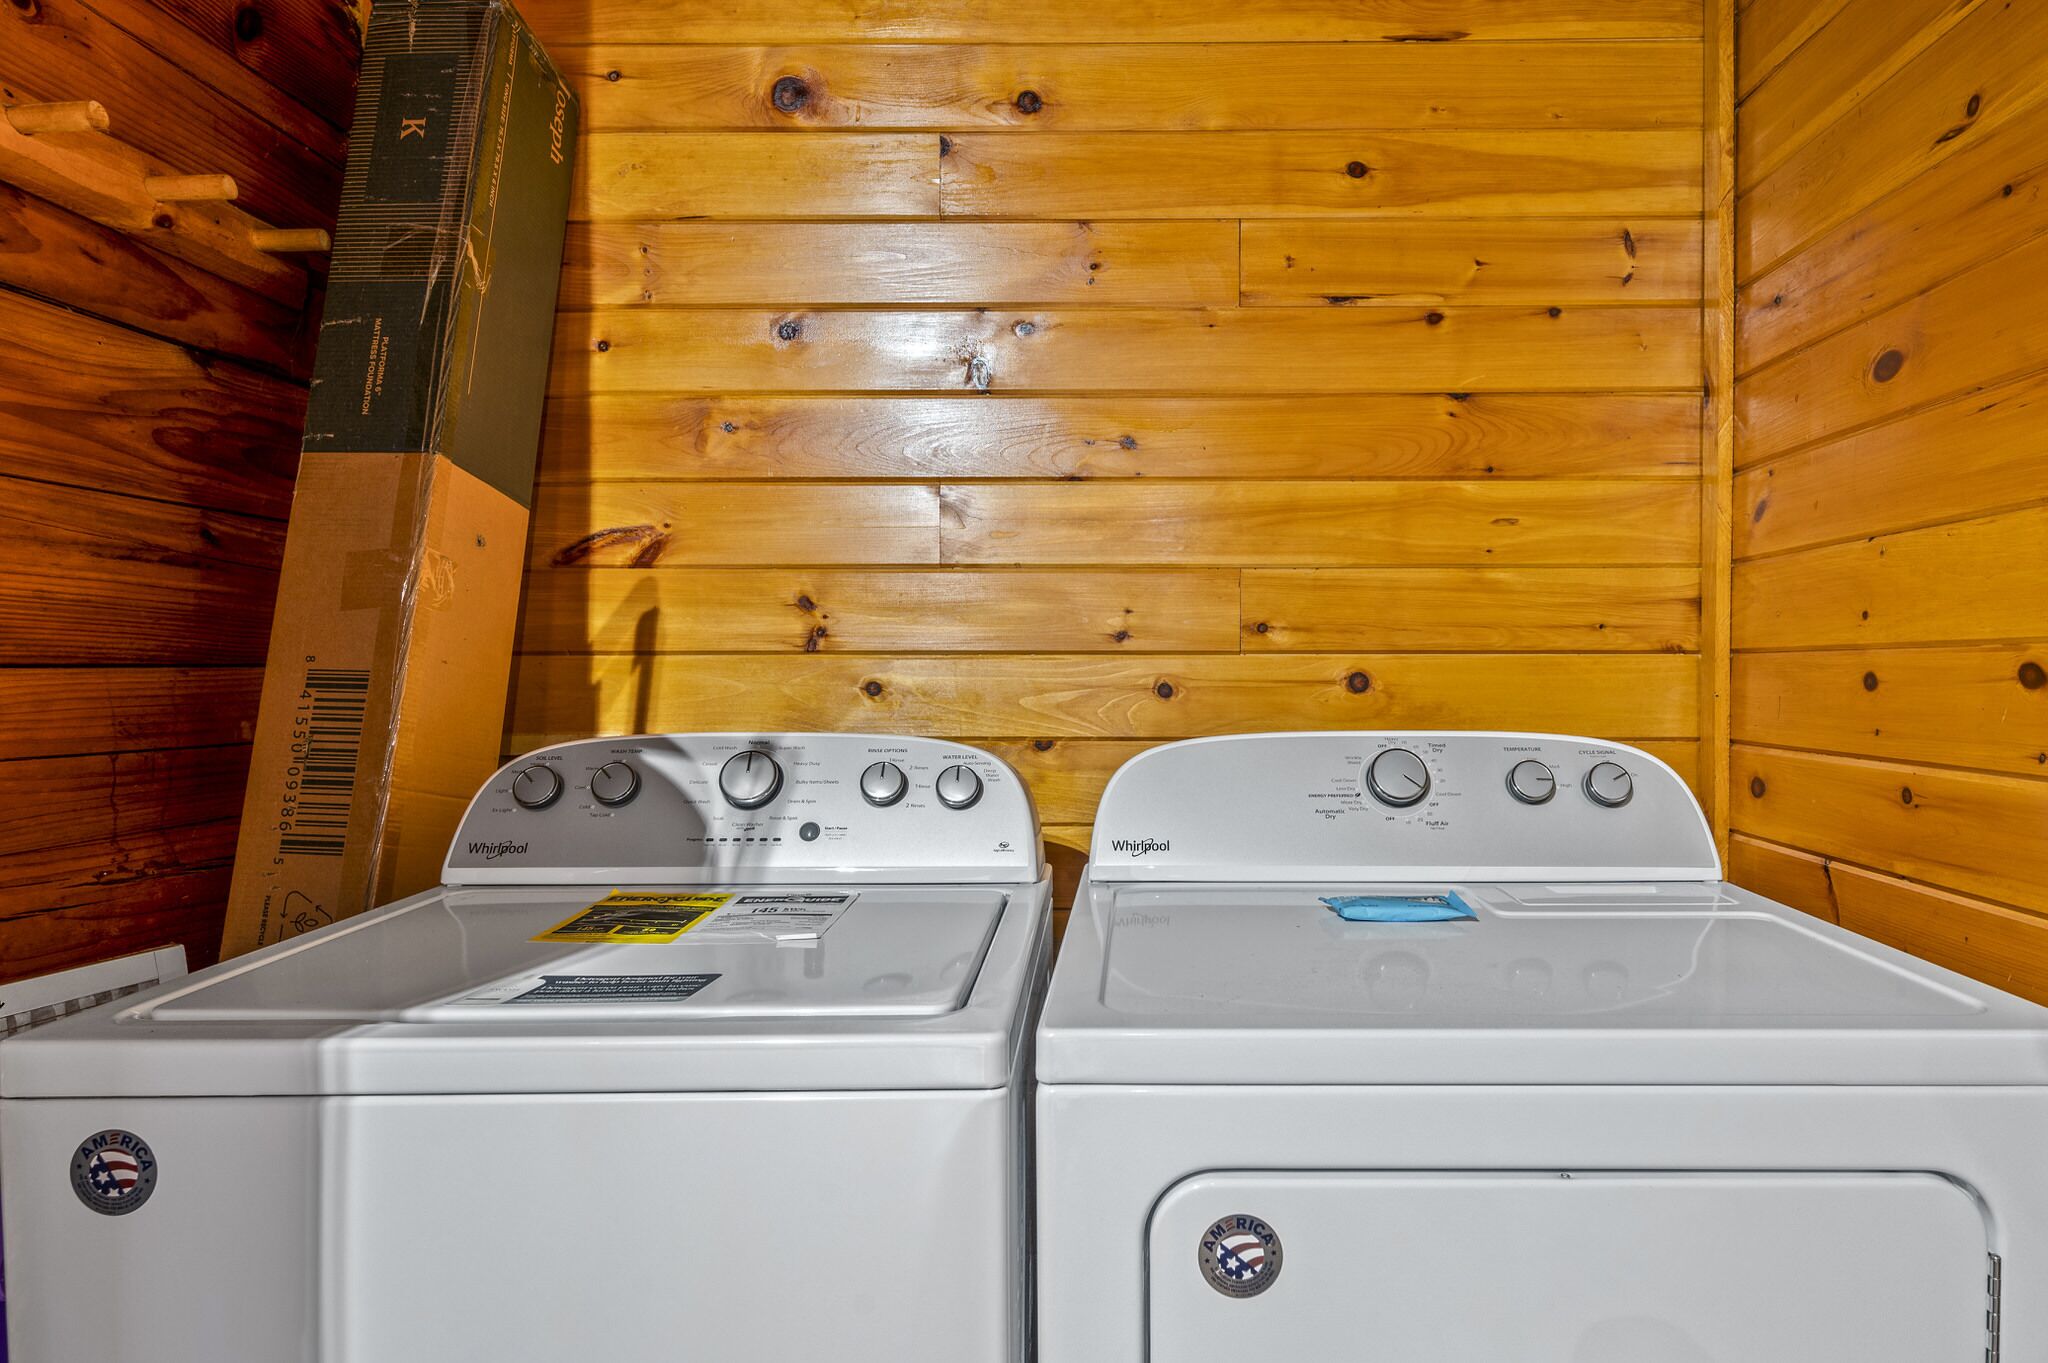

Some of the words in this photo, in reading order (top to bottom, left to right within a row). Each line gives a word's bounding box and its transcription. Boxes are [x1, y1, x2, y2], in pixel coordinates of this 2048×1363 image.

[400, 117, 426, 139] K
[369, 318, 382, 360] MATTRESS
[376, 336, 389, 385] PLATFORMA
[361, 361, 376, 415] FOUNDATION
[305, 655, 316, 663] 8
[469, 841, 528, 860] Whirlpool
[1112, 838, 1170, 857] Whirlpool
[262, 895, 271, 918] PLEASE
[81, 1132, 153, 1172] AMERICA
[1203, 1216, 1274, 1253] AMERICA
